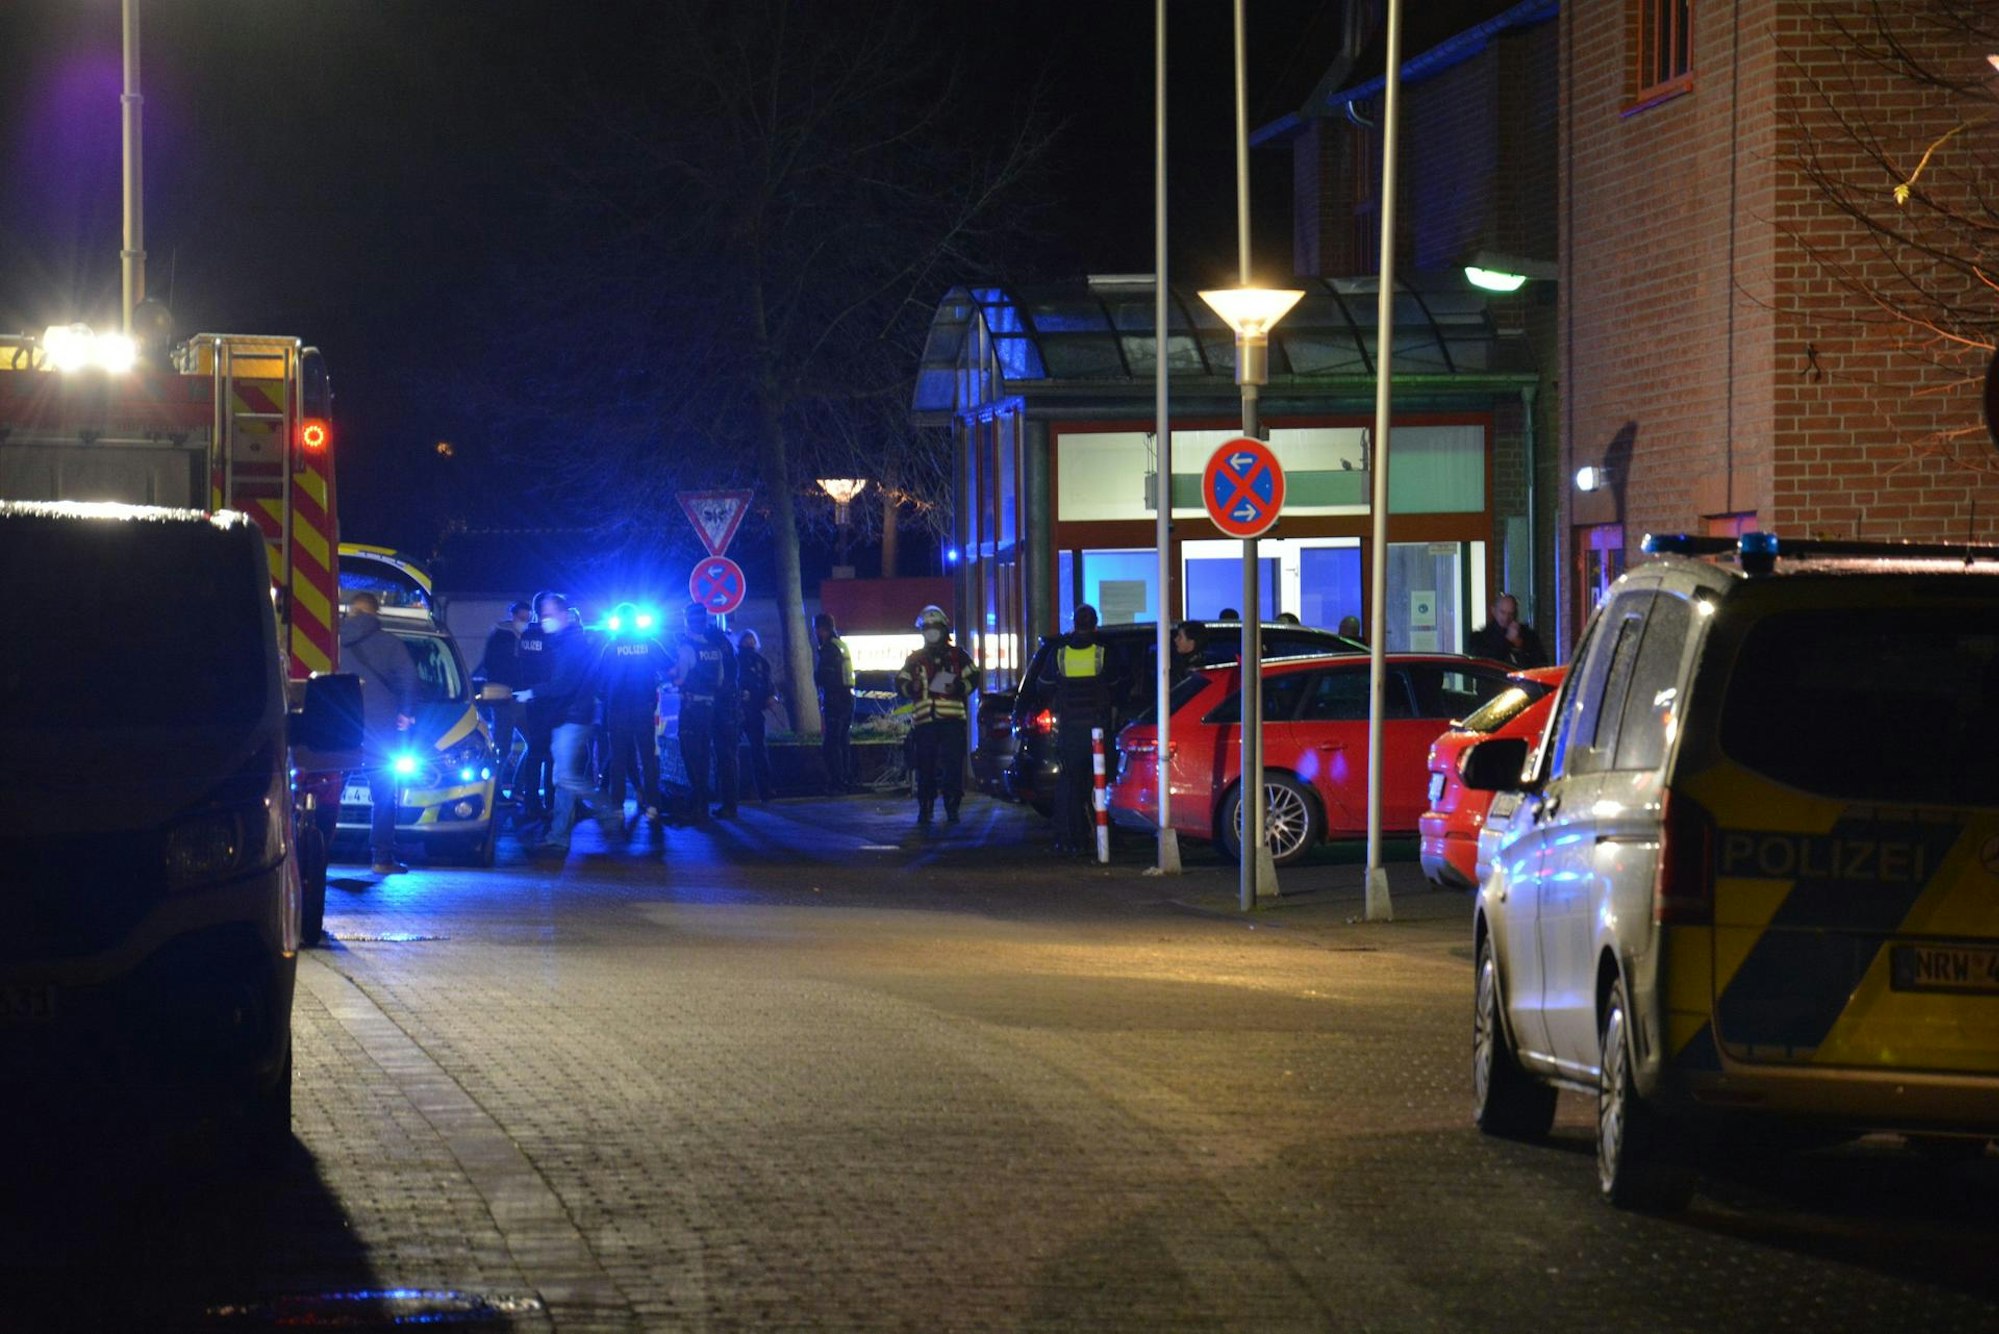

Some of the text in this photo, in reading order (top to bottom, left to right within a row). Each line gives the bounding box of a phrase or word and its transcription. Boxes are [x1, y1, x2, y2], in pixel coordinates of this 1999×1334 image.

[617, 643, 649, 657] POLIZEI
[1725, 835, 1924, 882] POLIZEI
[1916, 948, 1969, 980] NRW
